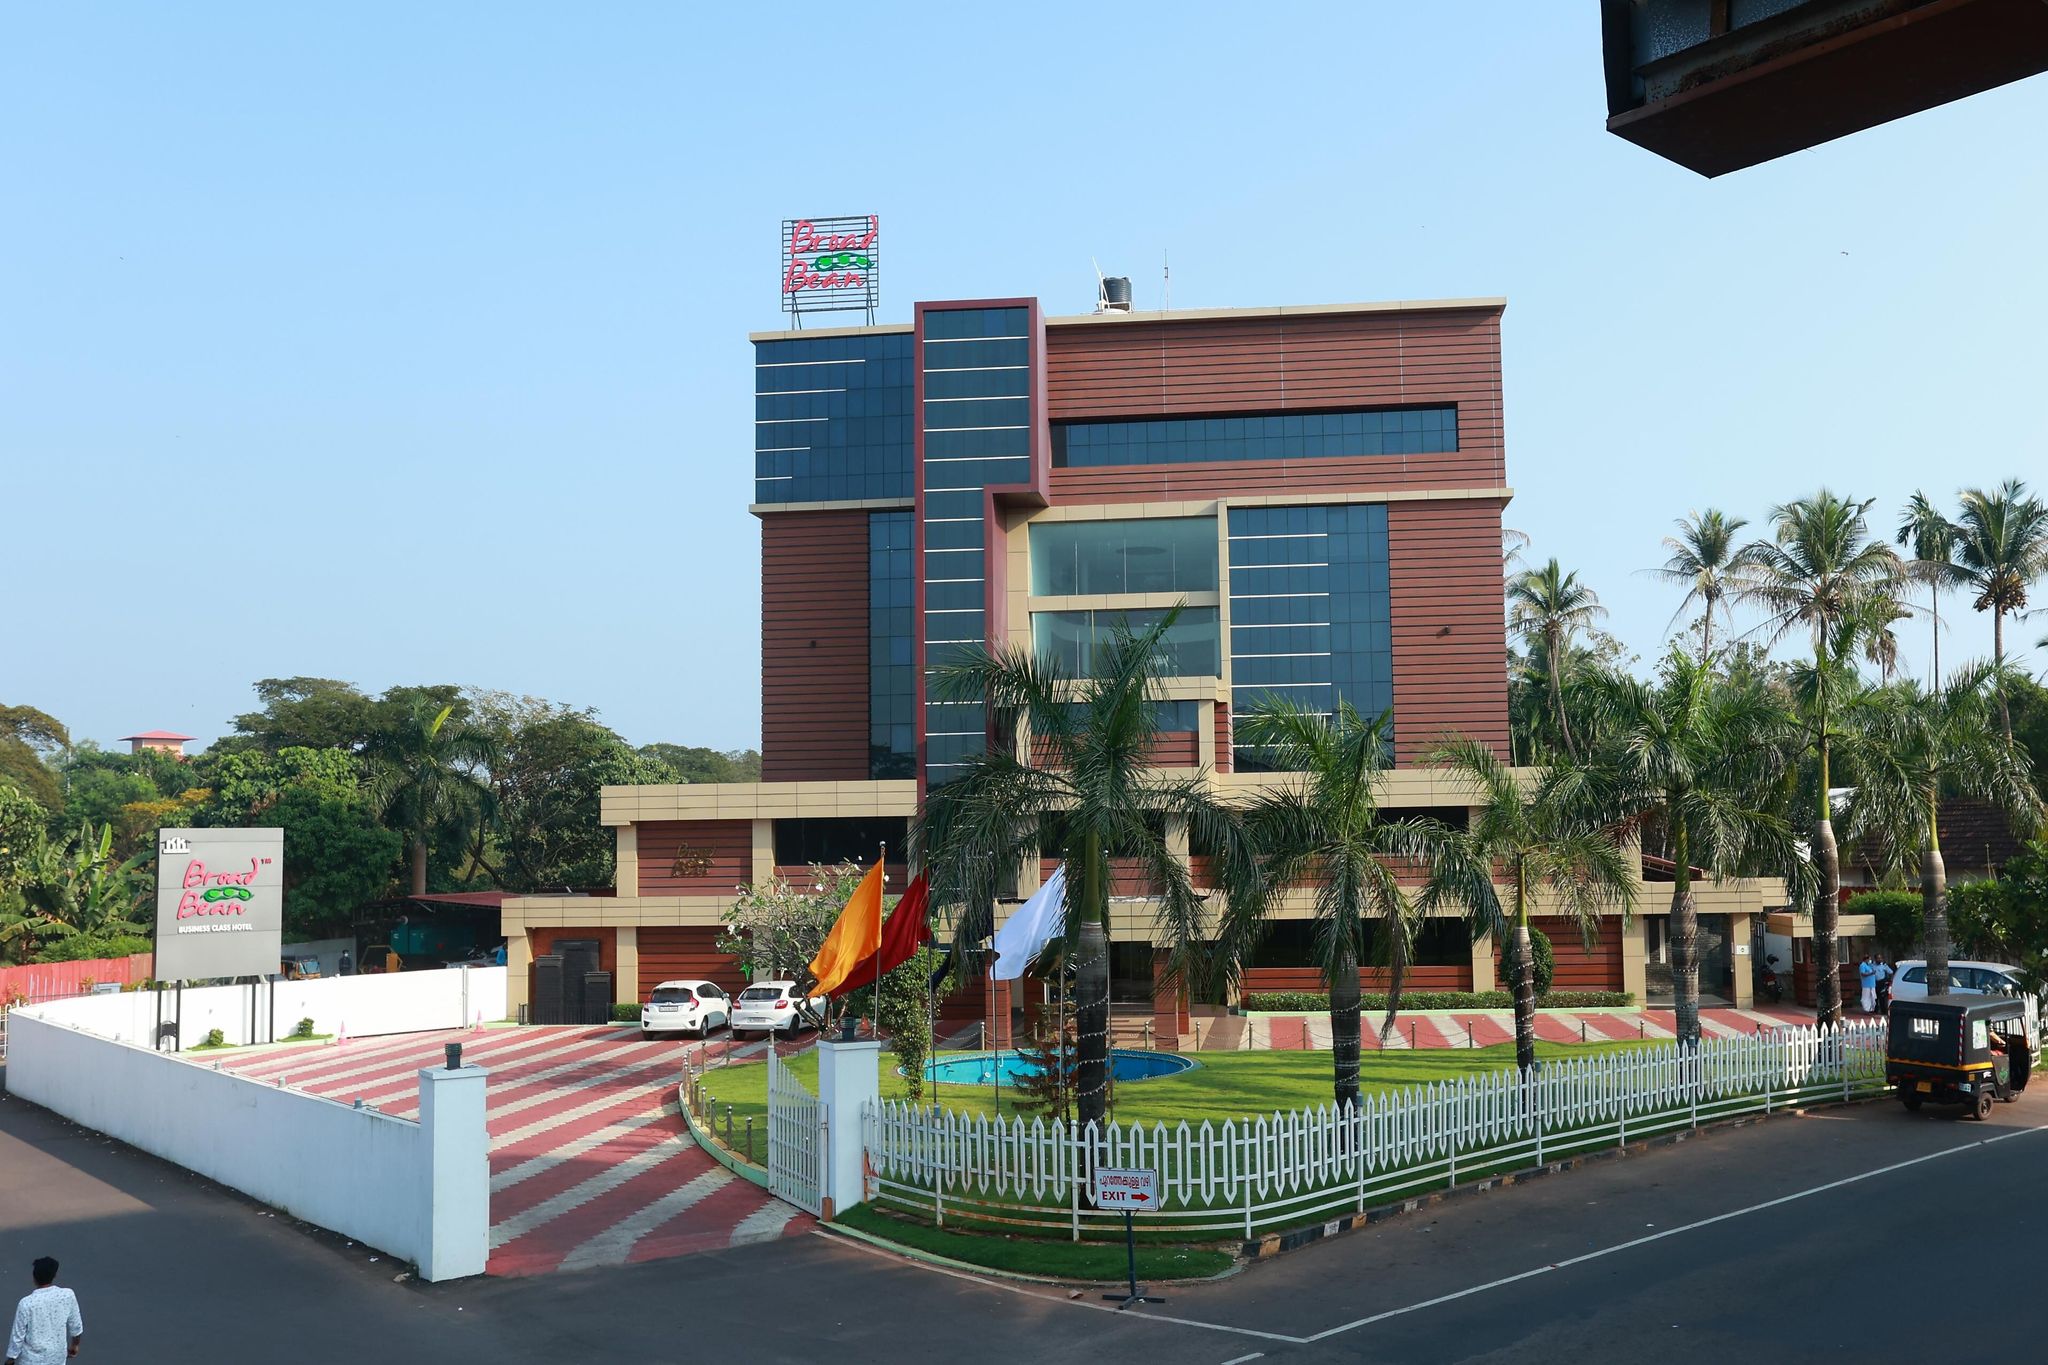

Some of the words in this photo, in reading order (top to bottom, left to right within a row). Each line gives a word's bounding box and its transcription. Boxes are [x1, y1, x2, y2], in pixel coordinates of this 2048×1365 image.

[790, 214, 877, 255] Broad
[783, 258, 864, 294] Bean
[183, 856, 259, 889] Broad
[177, 890, 246, 920] Bean
[178, 924, 210, 934] BUSINESS
[211, 924, 231, 932] CLASS
[231, 923, 253, 931] HOTEL
[1102, 1191, 1127, 1201] EXIT
